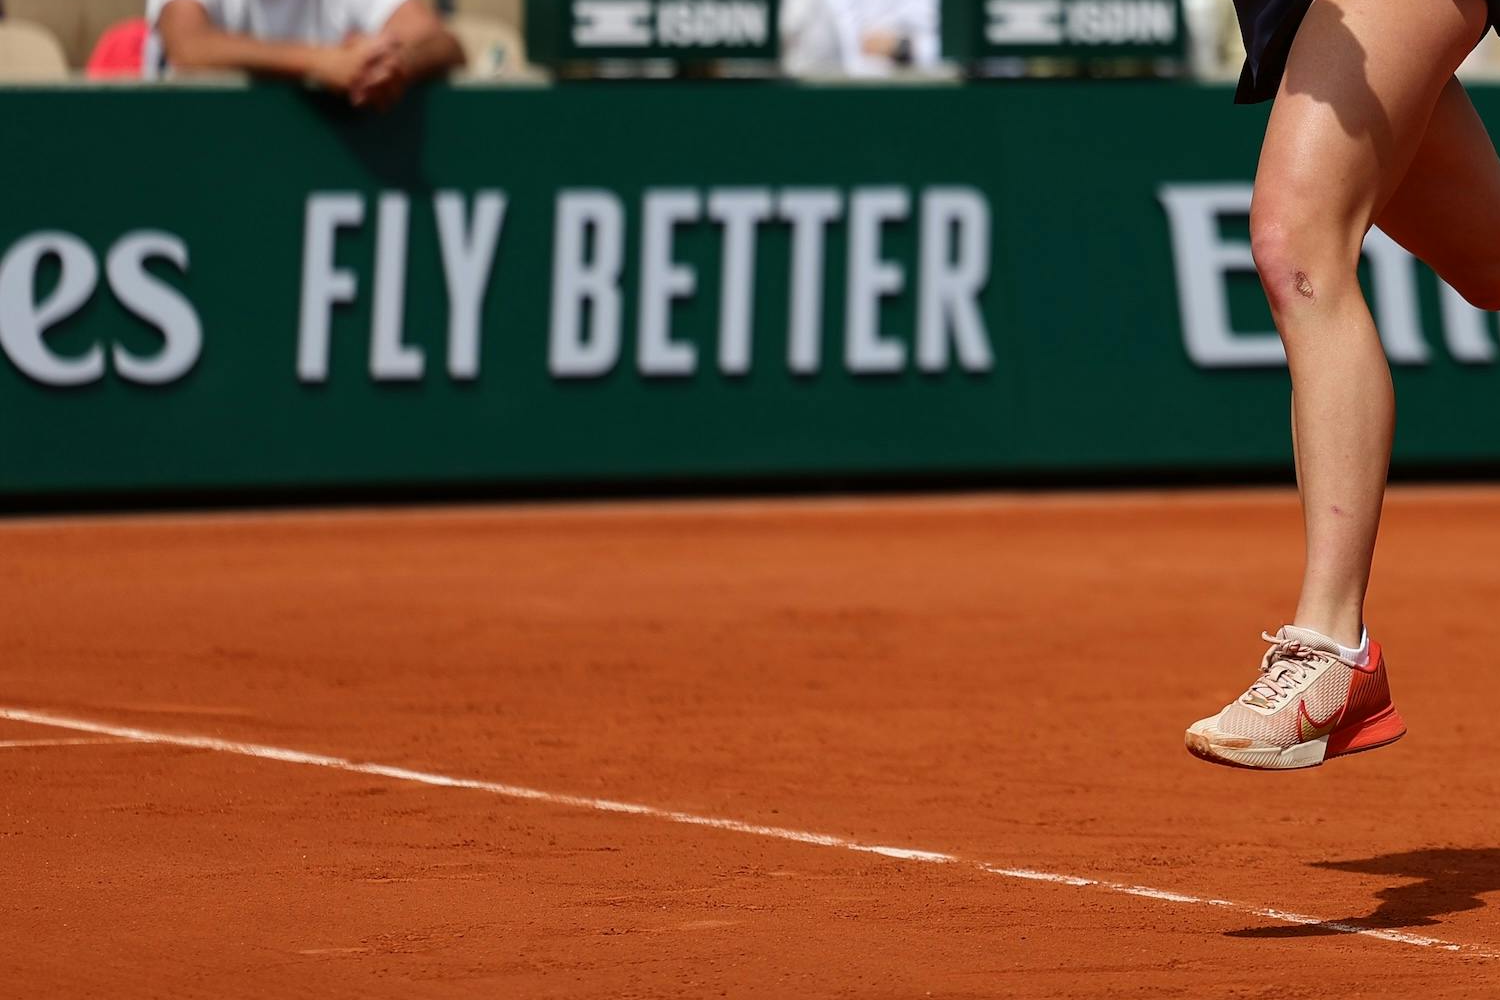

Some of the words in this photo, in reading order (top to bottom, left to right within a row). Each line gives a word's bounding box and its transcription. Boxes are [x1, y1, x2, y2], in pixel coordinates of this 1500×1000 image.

[0, 231, 202, 383] es
[297, 191, 507, 380] FLY
[548, 186, 993, 376] BETTER
